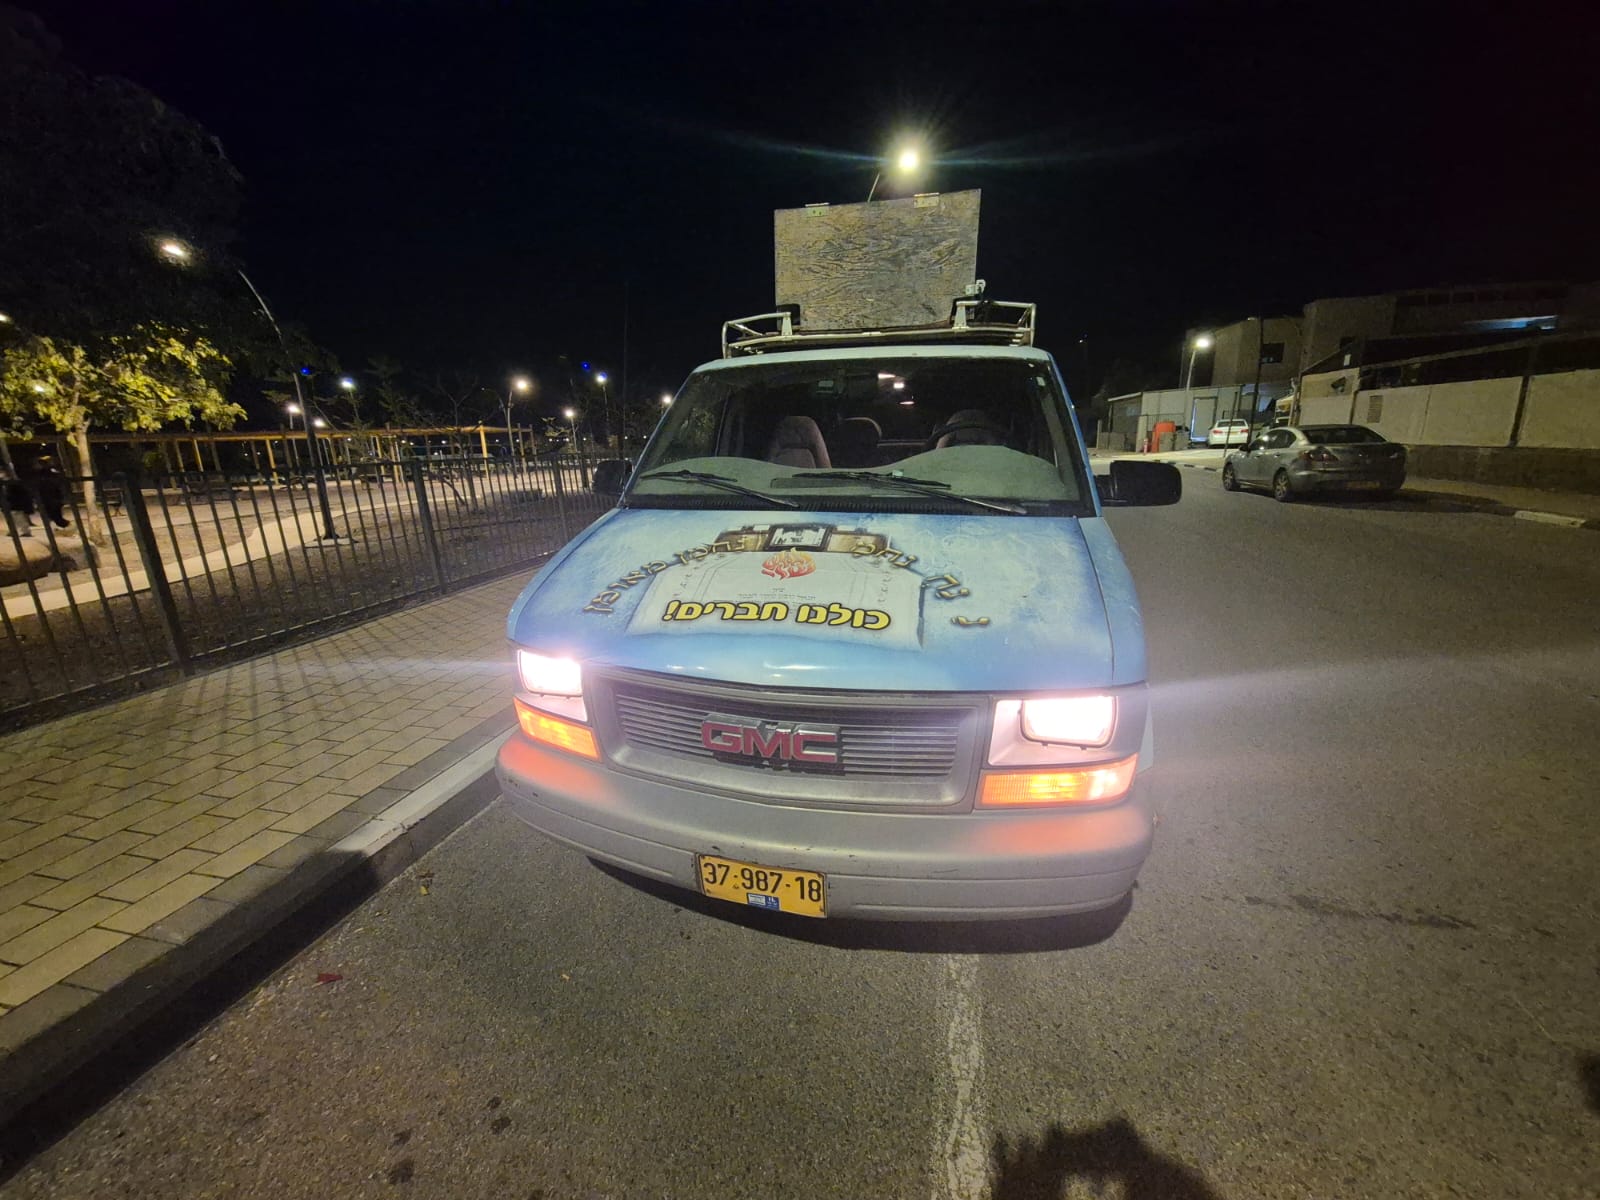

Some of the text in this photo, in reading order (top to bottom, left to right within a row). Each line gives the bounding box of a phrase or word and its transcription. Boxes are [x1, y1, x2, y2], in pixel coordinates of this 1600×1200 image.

[673, 536, 747, 565] נחמן
[582, 560, 669, 613] מאומן
[919, 573, 970, 599] נח
[662, 600, 891, 630] כולנו חברים!
[702, 719, 838, 763] GMC
